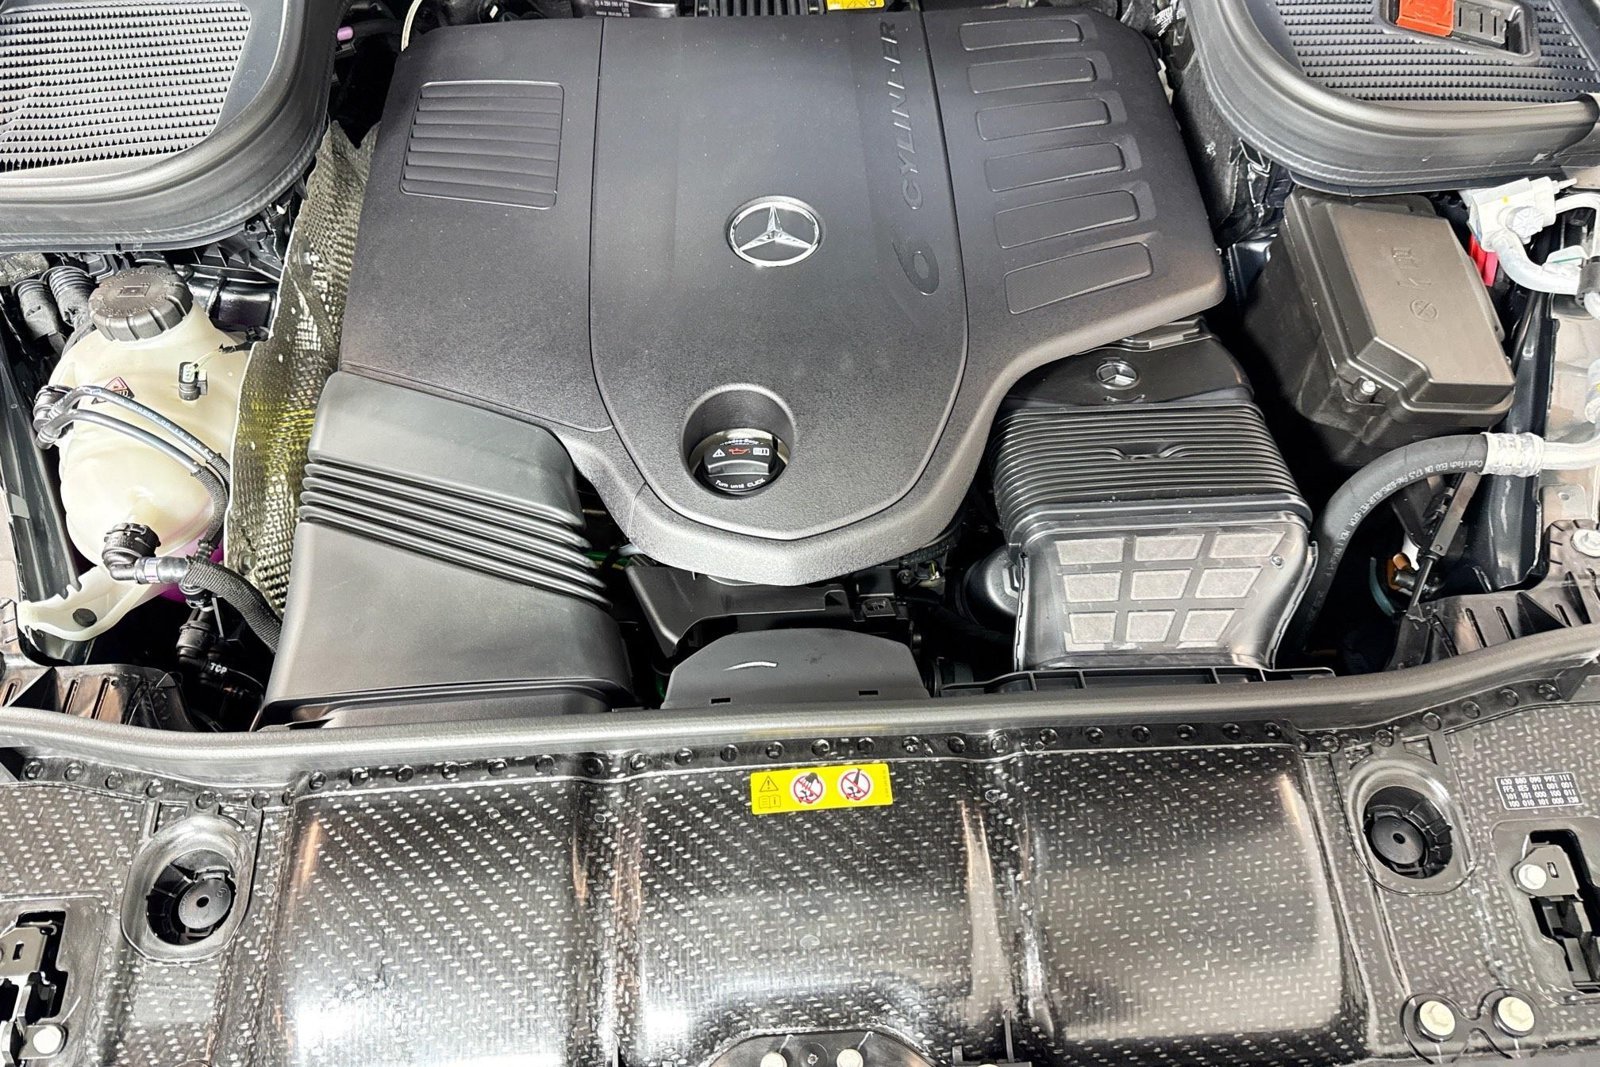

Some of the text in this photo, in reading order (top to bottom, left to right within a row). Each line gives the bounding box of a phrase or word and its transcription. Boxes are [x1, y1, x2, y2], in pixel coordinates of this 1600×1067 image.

[880, 21, 924, 211] CYLINDER
[715, 479, 729, 488] Turn
[746, 478, 766, 488] CLICK
[1543, 775, 1556, 783] 992
[1546, 782, 1559, 790] 001
[1522, 799, 1535, 807] 010
[1551, 797, 1565, 805] 000
